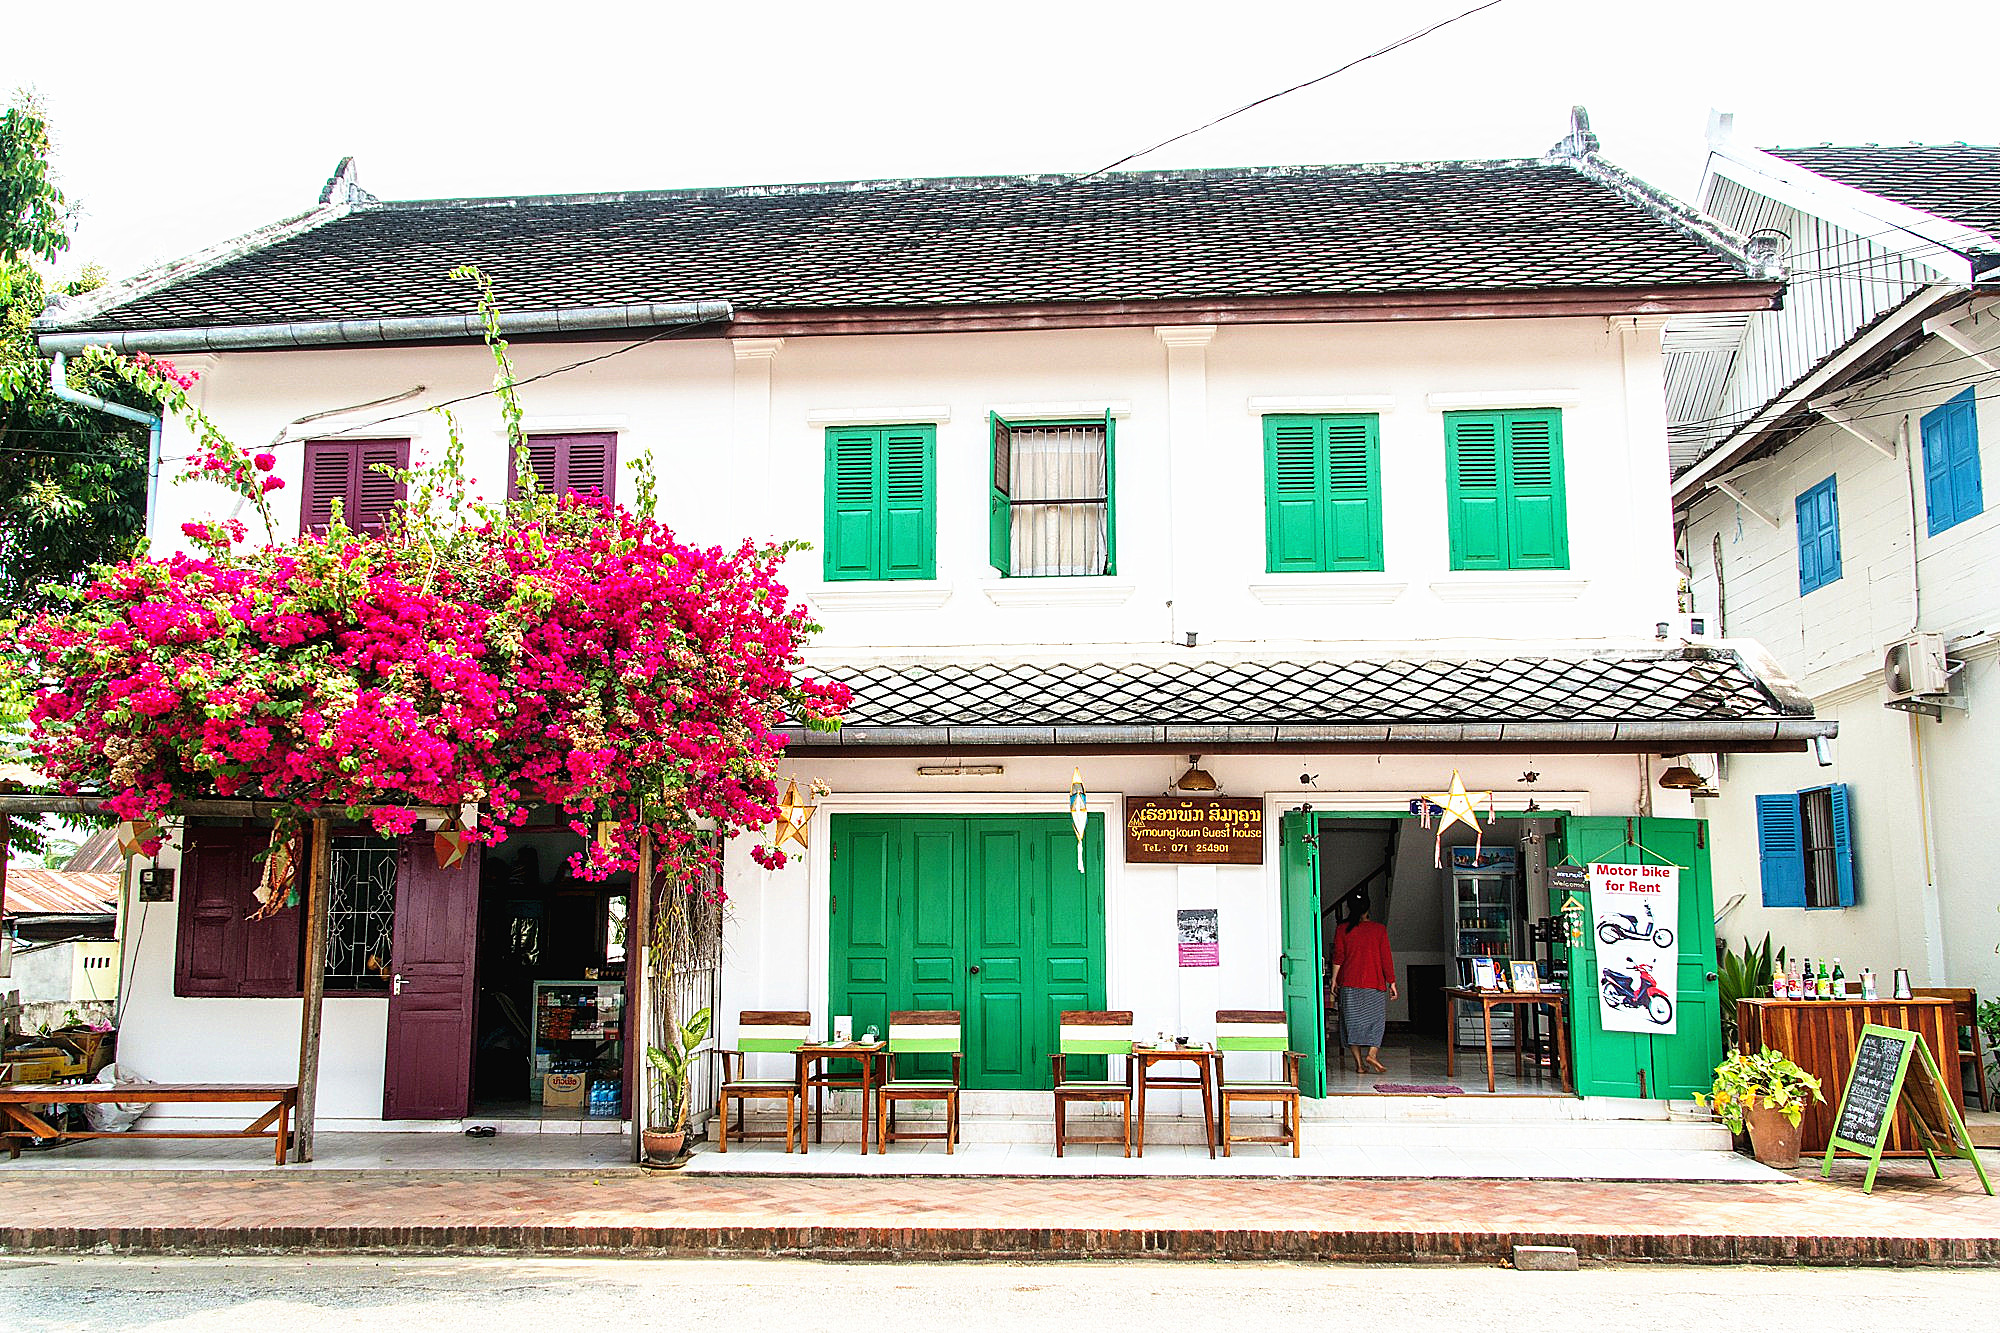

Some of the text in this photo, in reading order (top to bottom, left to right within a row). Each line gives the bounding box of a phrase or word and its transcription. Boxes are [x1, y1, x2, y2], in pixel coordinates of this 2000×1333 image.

[1202, 826, 1230, 838] Guest
[1232, 826, 1262, 838] house
[1171, 844, 1188, 853] 071
[1196, 844, 1229, 853] 254901
[1596, 864, 1670, 878] Motor bike
[1605, 879, 1661, 893] for Rent
